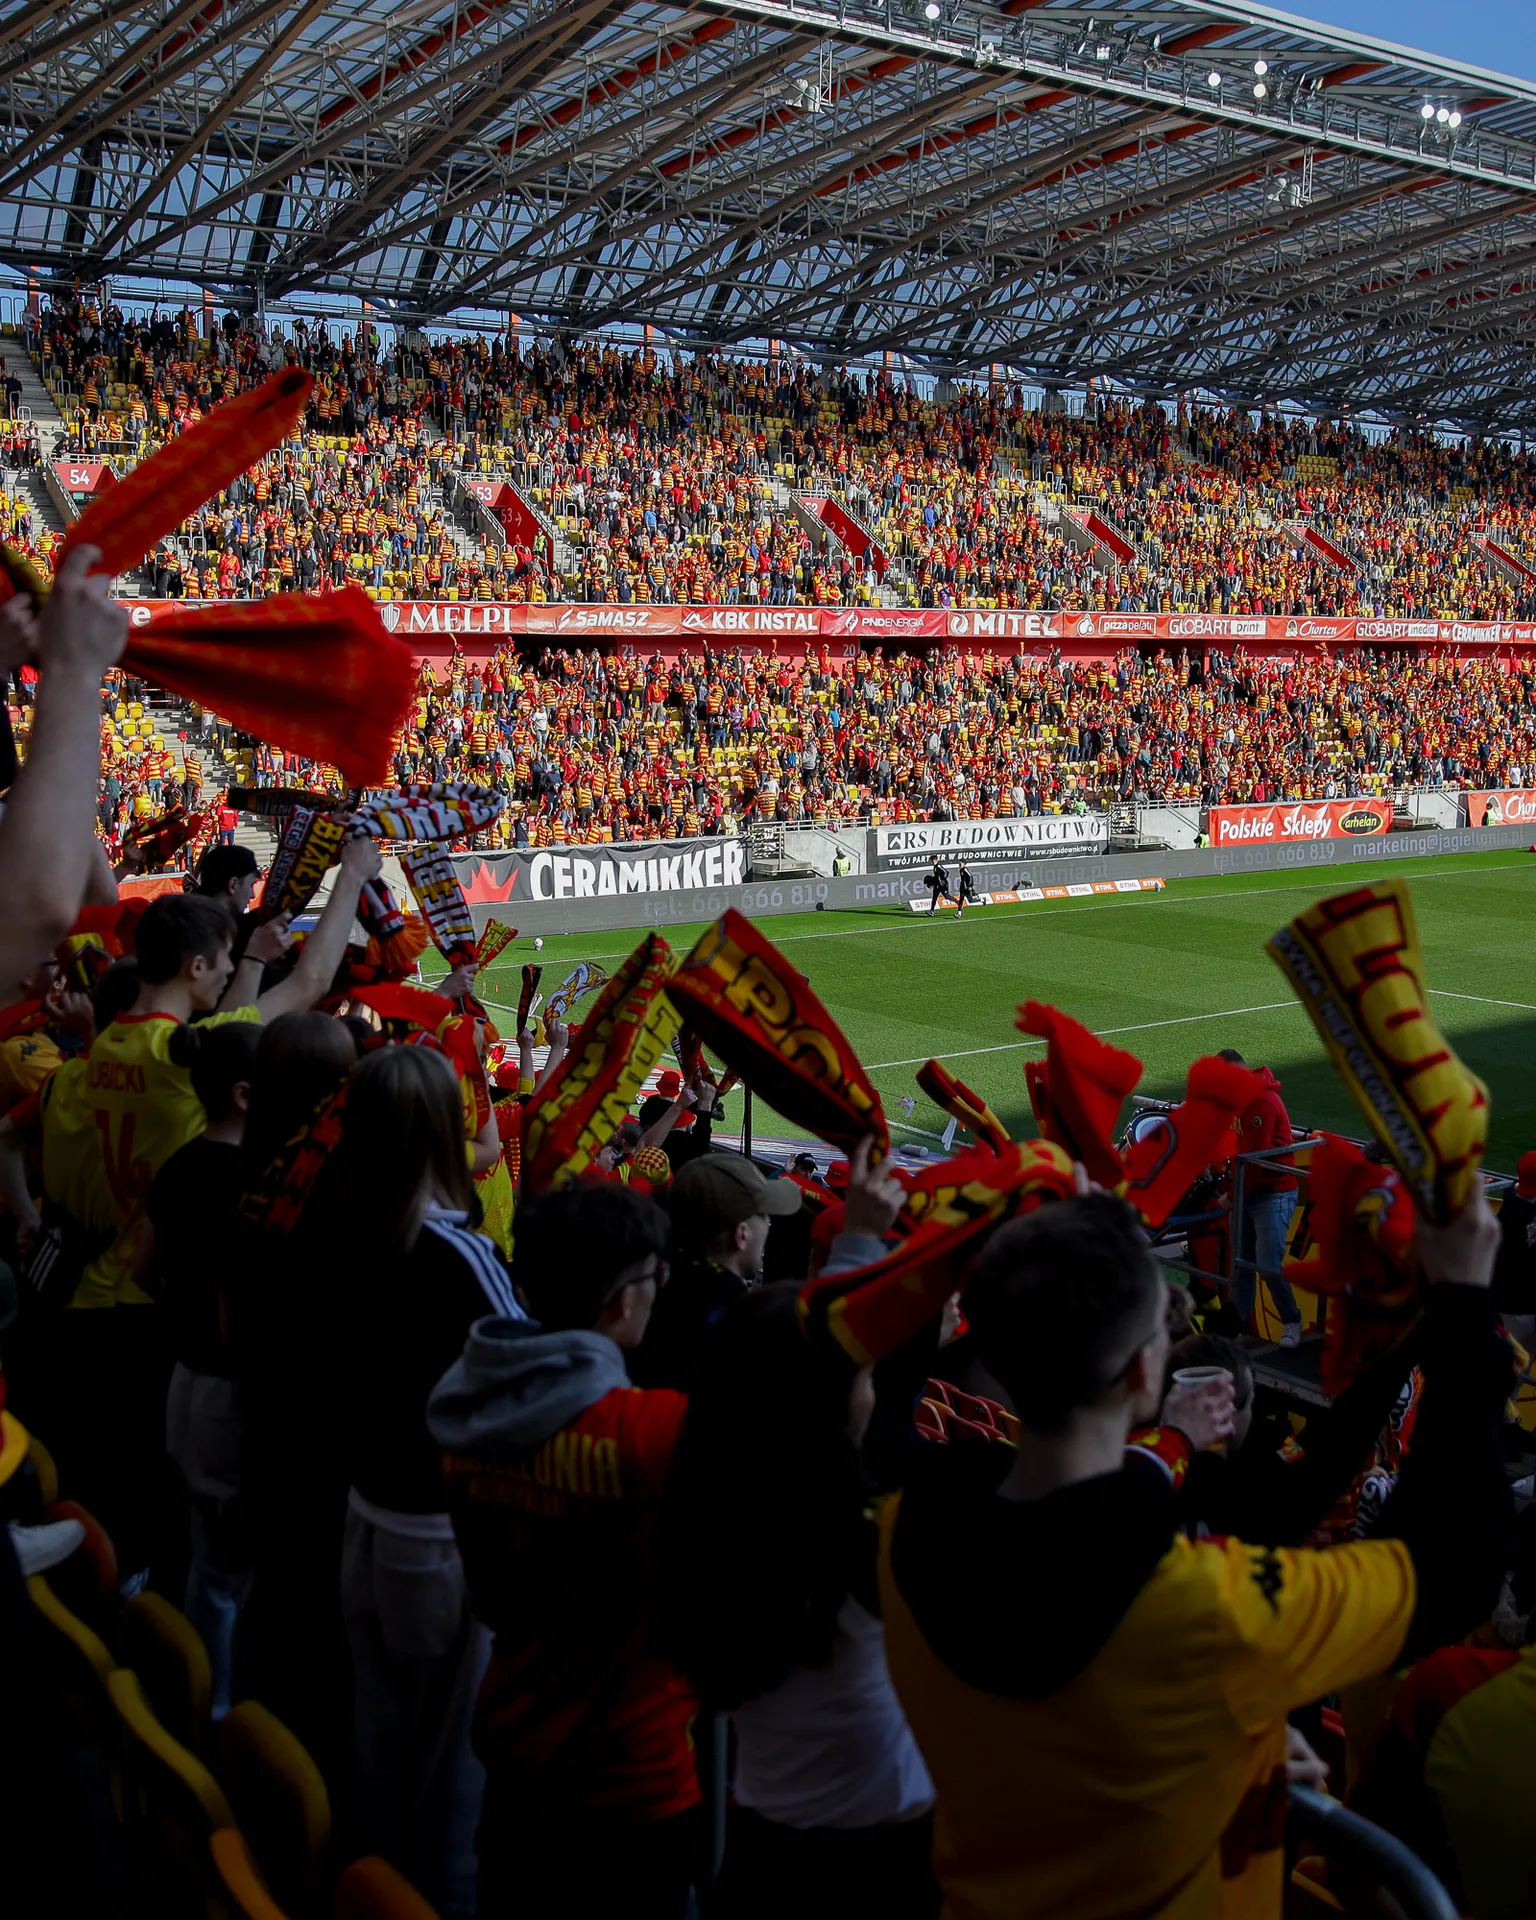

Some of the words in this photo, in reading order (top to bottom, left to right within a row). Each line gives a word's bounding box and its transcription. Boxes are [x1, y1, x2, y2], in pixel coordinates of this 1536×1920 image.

[70, 469, 90, 485] 54
[476, 486, 493, 501] 53
[501, 508, 513, 524] 53
[408, 603, 513, 633] MELPI
[574, 610, 650, 628] SaMASZ
[712, 611, 751, 630] KBK
[754, 612, 819, 631] INSTAL
[973, 613, 1058, 636] MITEL
[1169, 619, 1230, 635] GLOBART
[1236, 622, 1260, 633] print
[1299, 620, 1338, 637] Chorten
[1356, 622, 1409, 637] GLOBART
[1410, 624, 1437, 636] media
[1451, 623, 1501, 642] CERAMIKKER
[622, 644, 635, 658] 21
[843, 644, 856, 657] 20
[1126, 646, 1135, 658] 19
[1219, 816, 1275, 841] Polskie
[1284, 811, 1332, 839] Sklepy
[1345, 815, 1379, 831] arhelan
[937, 820, 1100, 848] BUDOWNICTWO
[1213, 853, 1240, 869] tel:
[1245, 850, 1272, 866] 661
[1278, 846, 1306, 864] 666
[1310, 842, 1336, 861] 819
[1352, 828, 1525, 858] marketing@jagiellonia.pl
[888, 857, 911, 867] TWÓJ
[913, 853, 946, 864] PARTER
[948, 852, 957, 861] W
[958, 849, 1023, 860] BUDOWNICTWIE
[530, 840, 744, 900] CERAMIKKER
[1046, 888, 1067, 897] STIHL
[1070, 885, 1090, 894] STIHL
[1094, 883, 1115, 892] STIHL
[1119, 881, 1139, 890] STIHL
[643, 896, 682, 919] tel:
[692, 891, 731, 914] 661
[741, 887, 783, 910] 666
[791, 883, 829, 906] 819
[995, 893, 1016, 901] STIHL
[1022, 890, 1042, 899] STIHL
[915, 901, 931, 910] STIH
